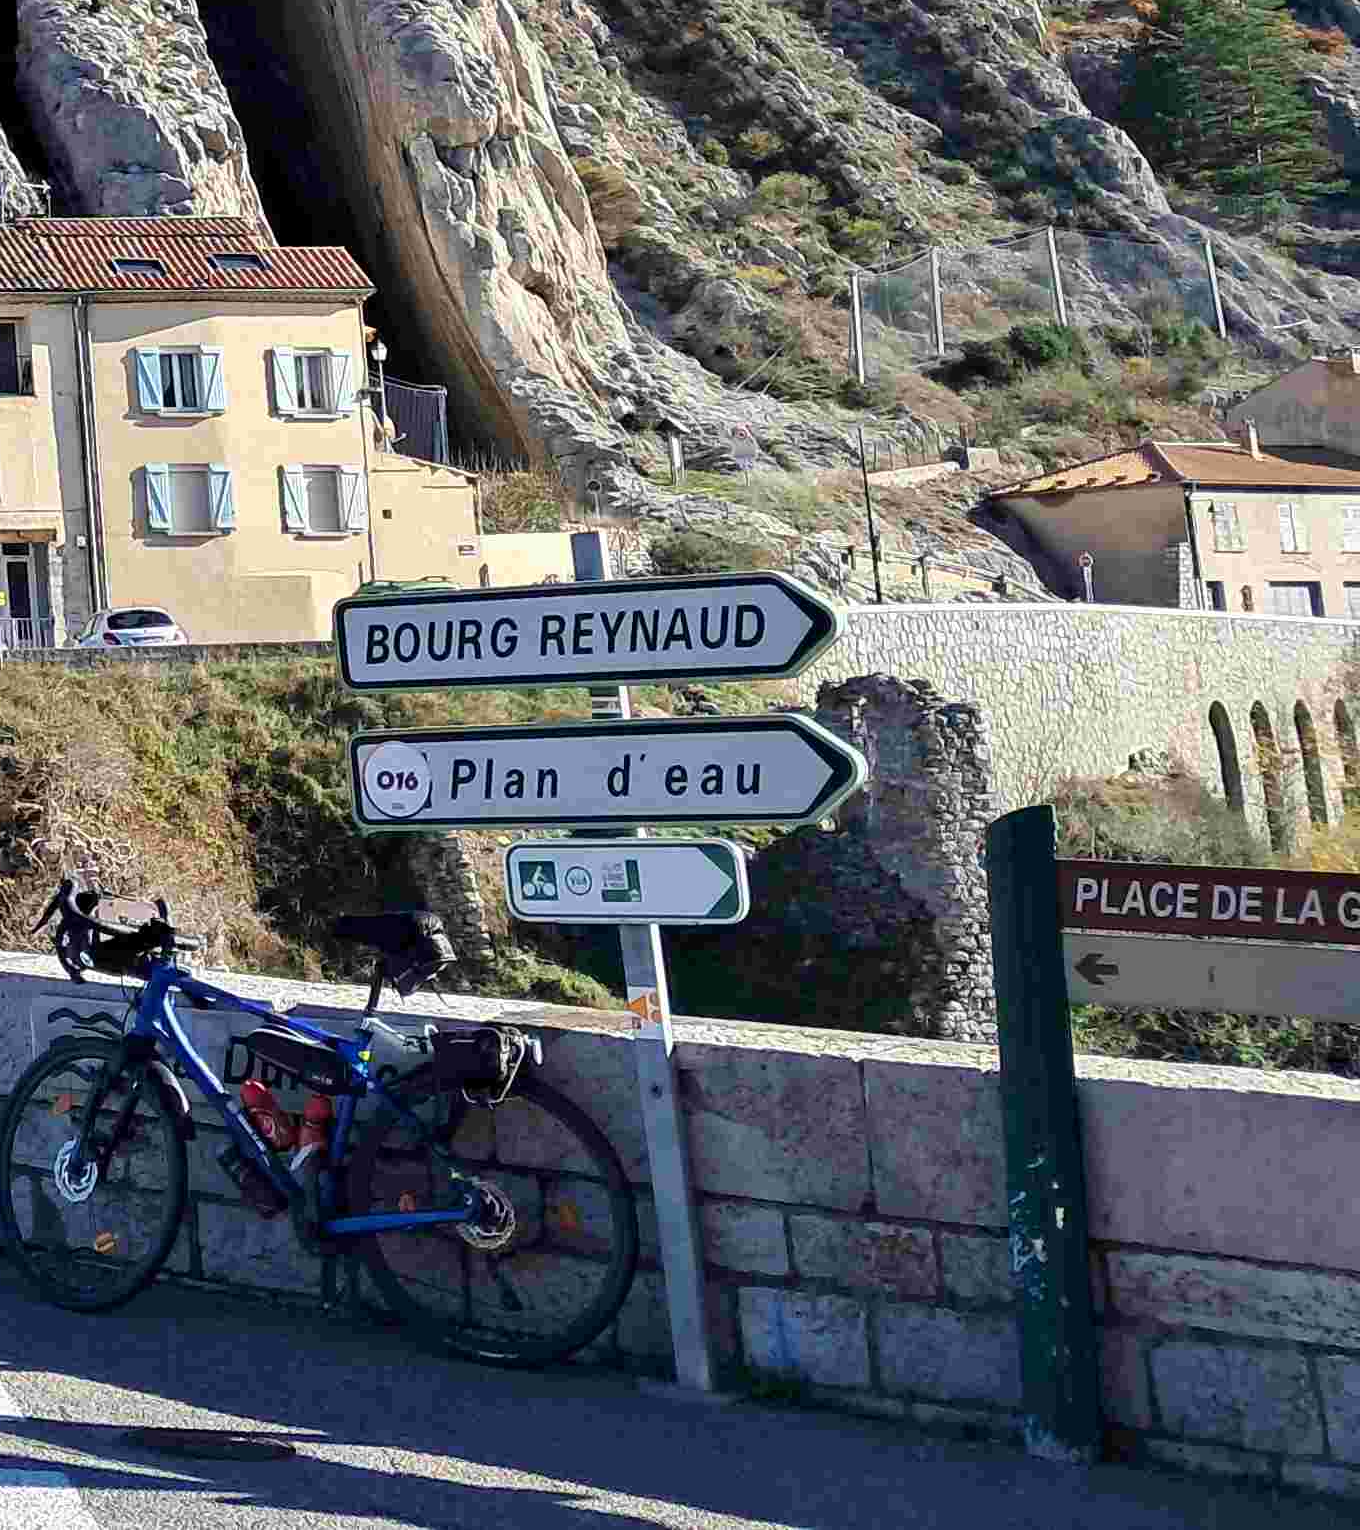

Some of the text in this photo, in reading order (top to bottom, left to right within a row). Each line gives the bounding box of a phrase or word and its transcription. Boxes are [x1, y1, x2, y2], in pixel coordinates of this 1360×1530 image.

[366, 604, 766, 664] BOURG REYNAUD
[451, 759, 559, 800] Plan
[1075, 877, 1201, 919] PLACE
[1211, 885, 1263, 922] DE
[1275, 888, 1326, 926] LA
